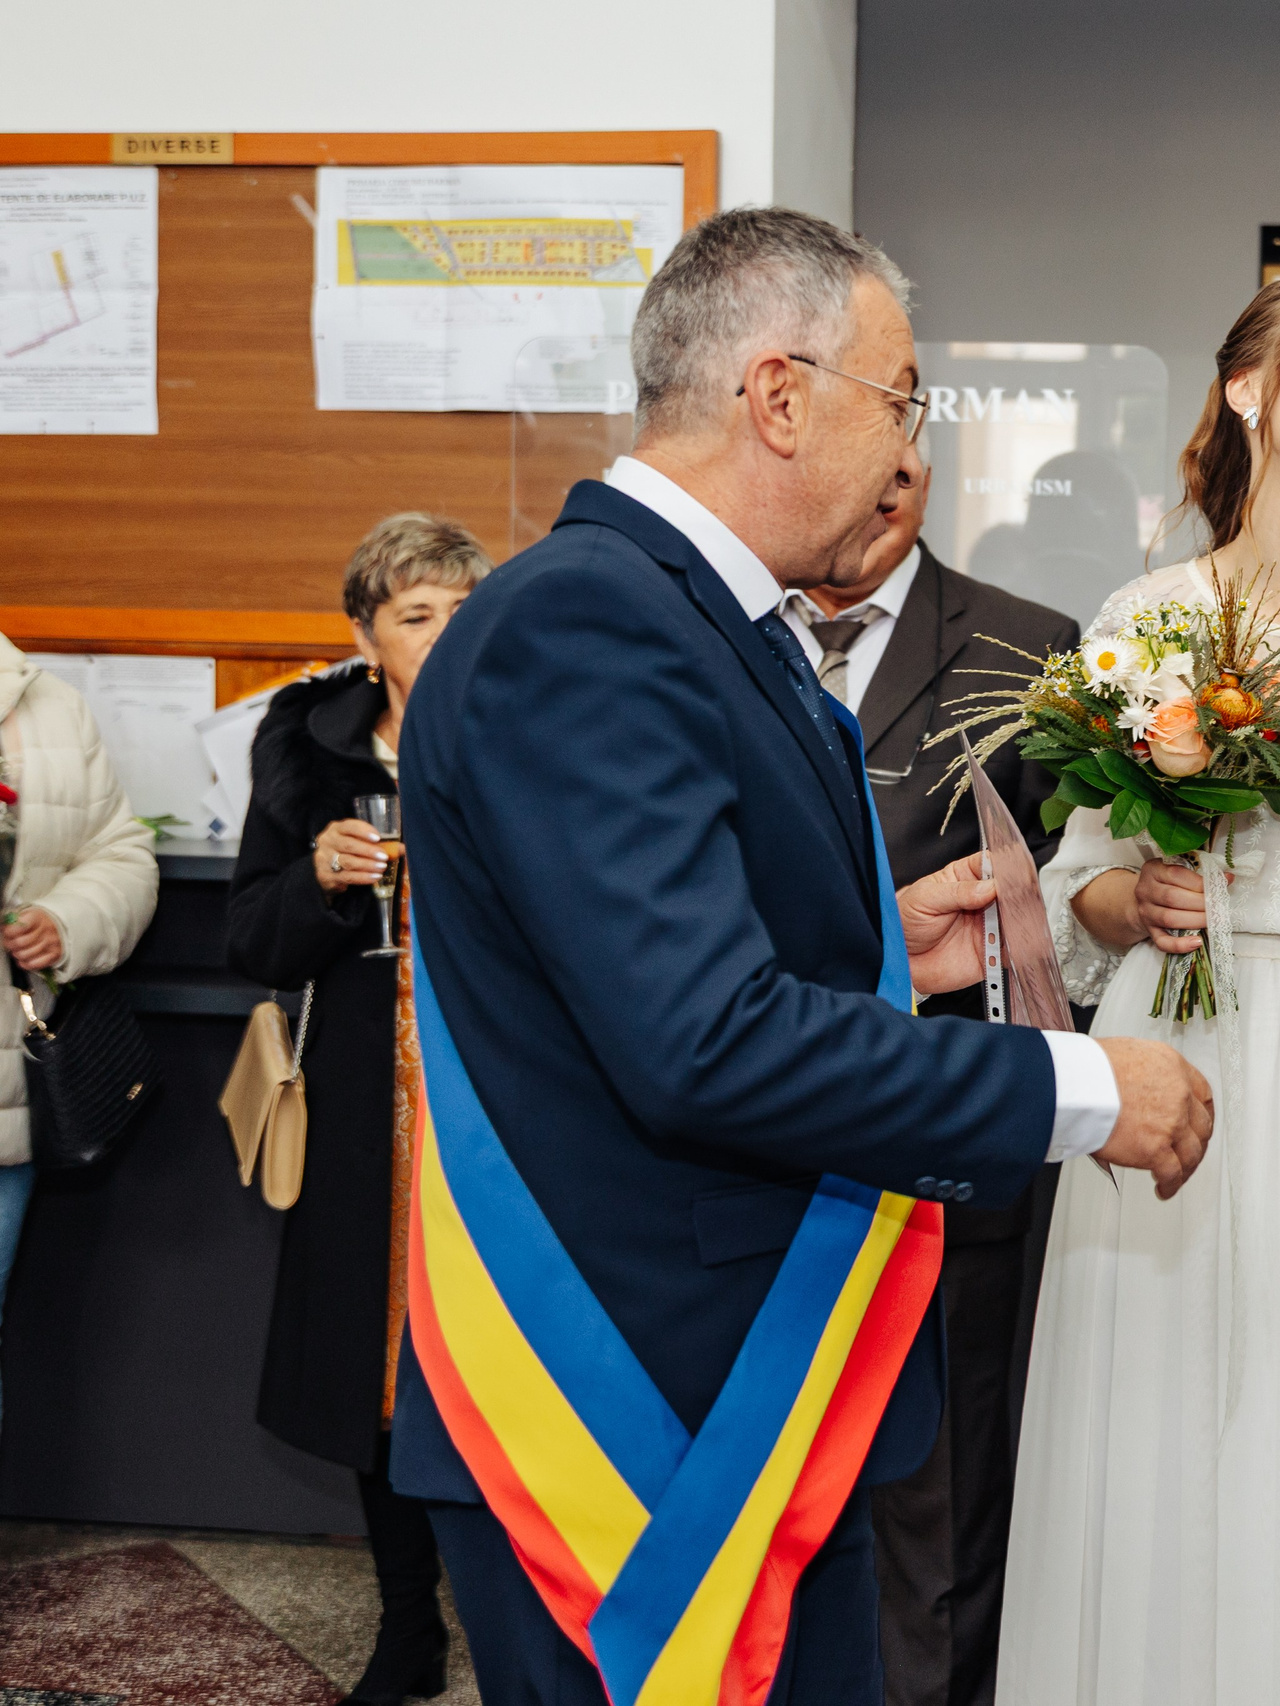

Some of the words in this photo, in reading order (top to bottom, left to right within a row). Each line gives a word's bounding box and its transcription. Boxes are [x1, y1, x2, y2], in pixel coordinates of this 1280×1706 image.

[126, 138, 221, 154] DIVERSE
[926, 386, 1076, 424] RMAN
[963, 477, 1073, 496] URBISM
